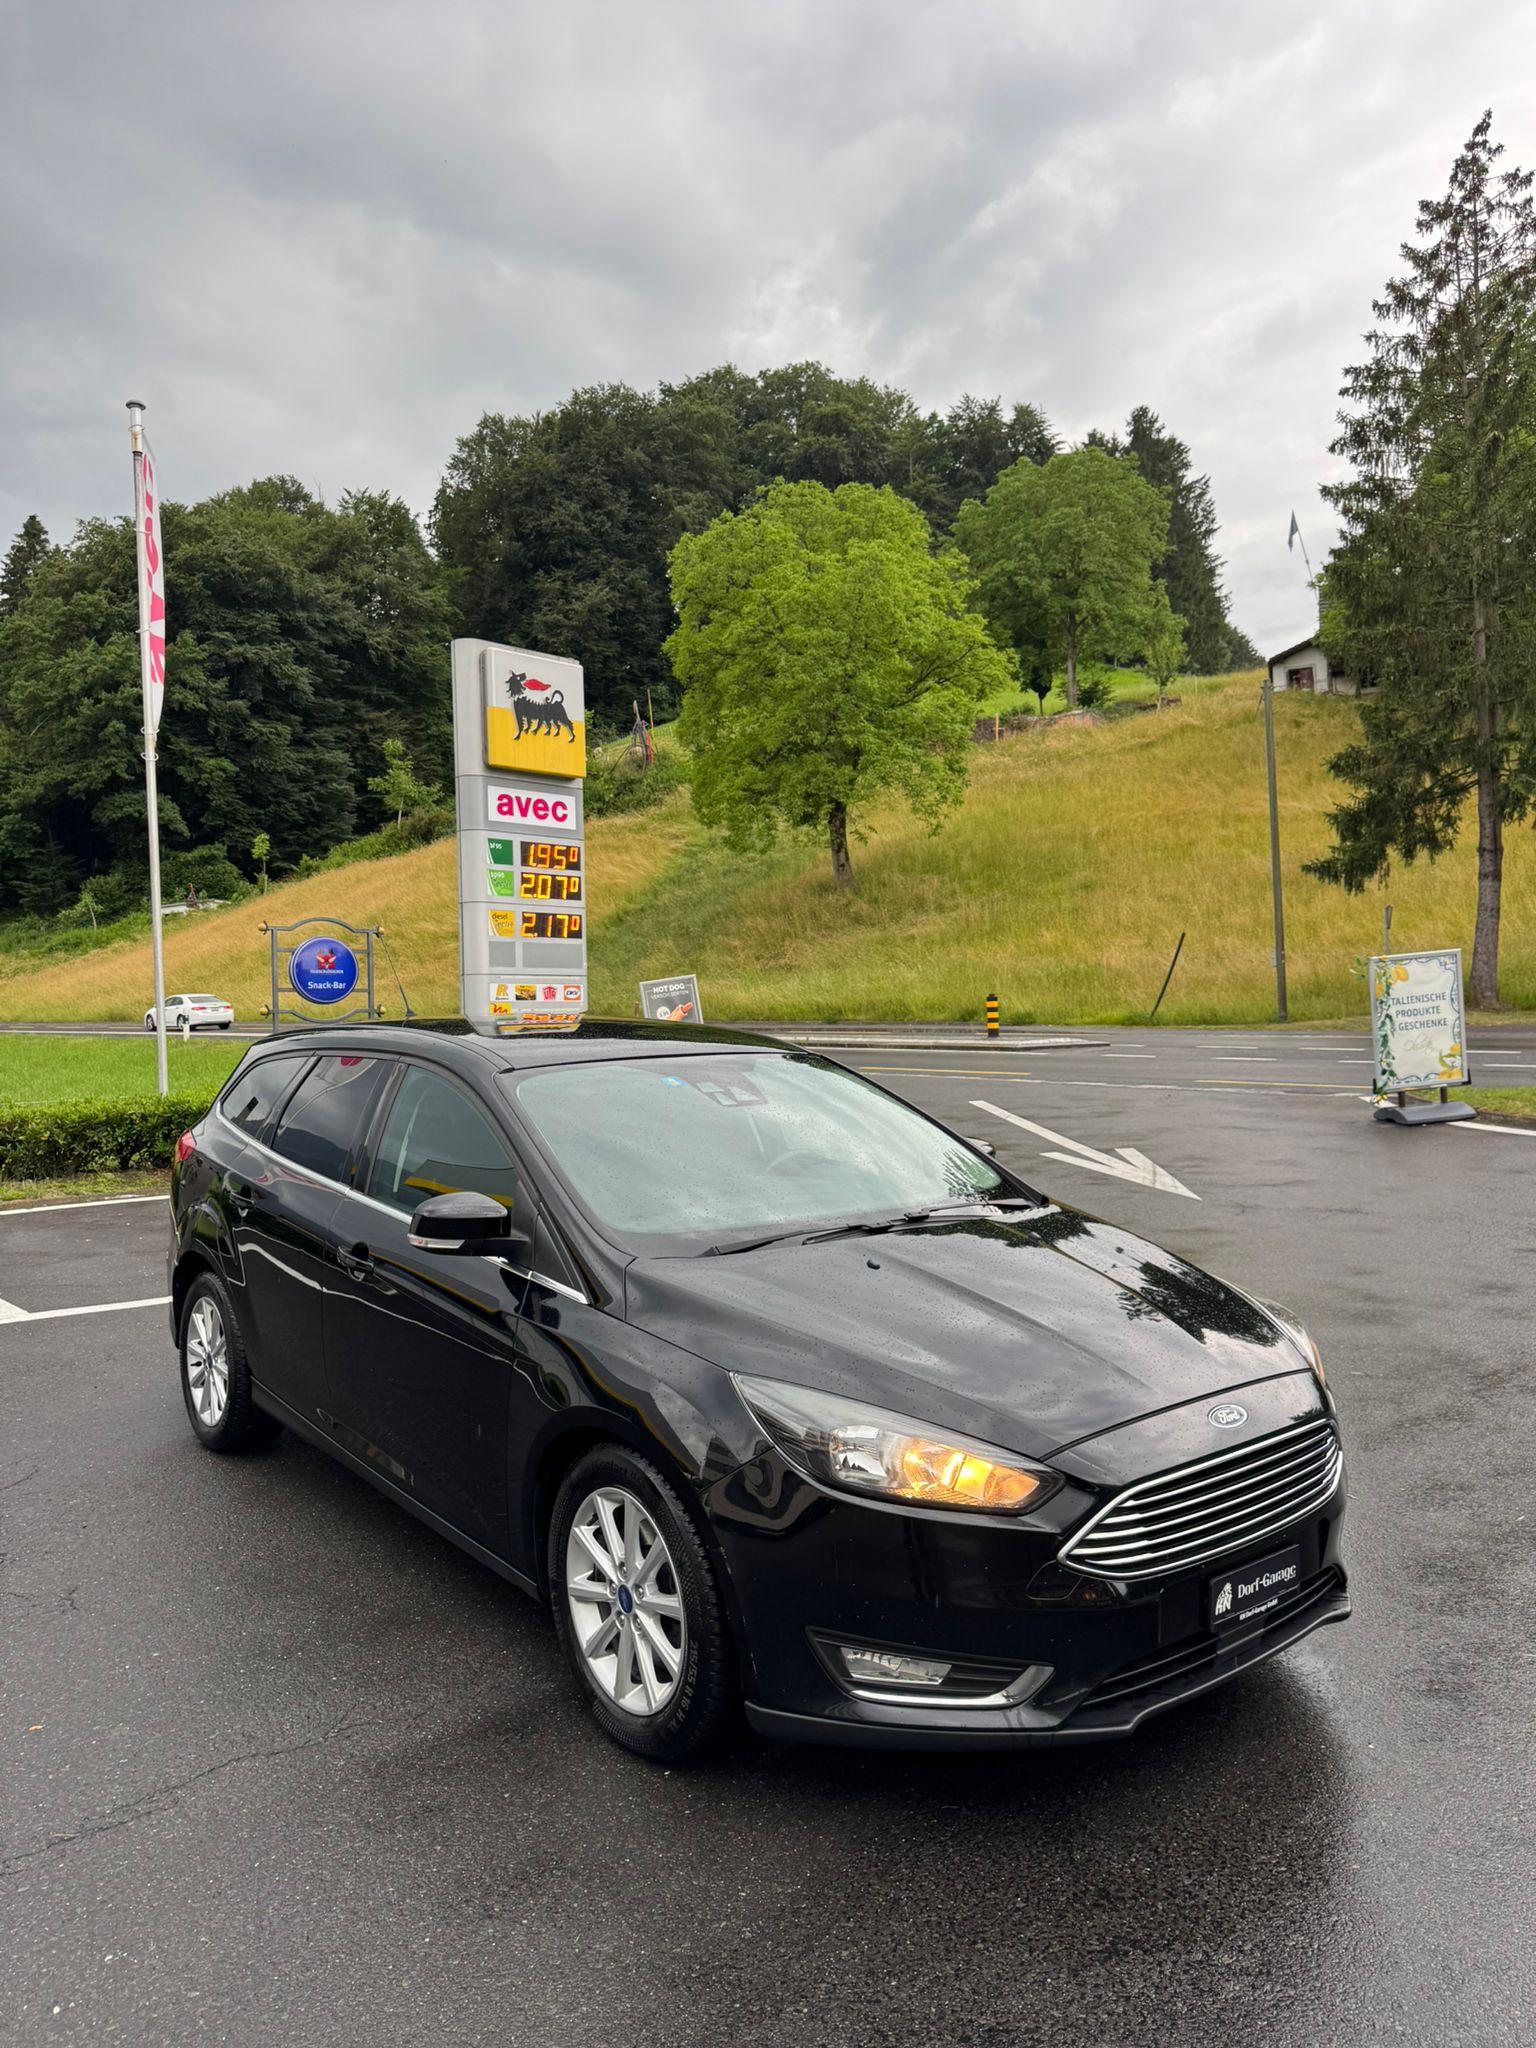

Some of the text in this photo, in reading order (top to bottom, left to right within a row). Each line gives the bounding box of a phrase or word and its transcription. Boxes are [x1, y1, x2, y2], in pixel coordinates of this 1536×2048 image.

[497, 793, 568, 822] avec
[307, 981, 347, 989] Snack-Bar
[653, 983, 685, 994] HOT DOG
[1391, 992, 1447, 1006] TALIENISCHE
[1395, 1005, 1441, 1018] PRODUKTE
[1398, 1018, 1448, 1031] GESCHENKE
[1238, 1565, 1296, 1599] Dorf-Garage
[687, 1640, 699, 1685] 215/55
